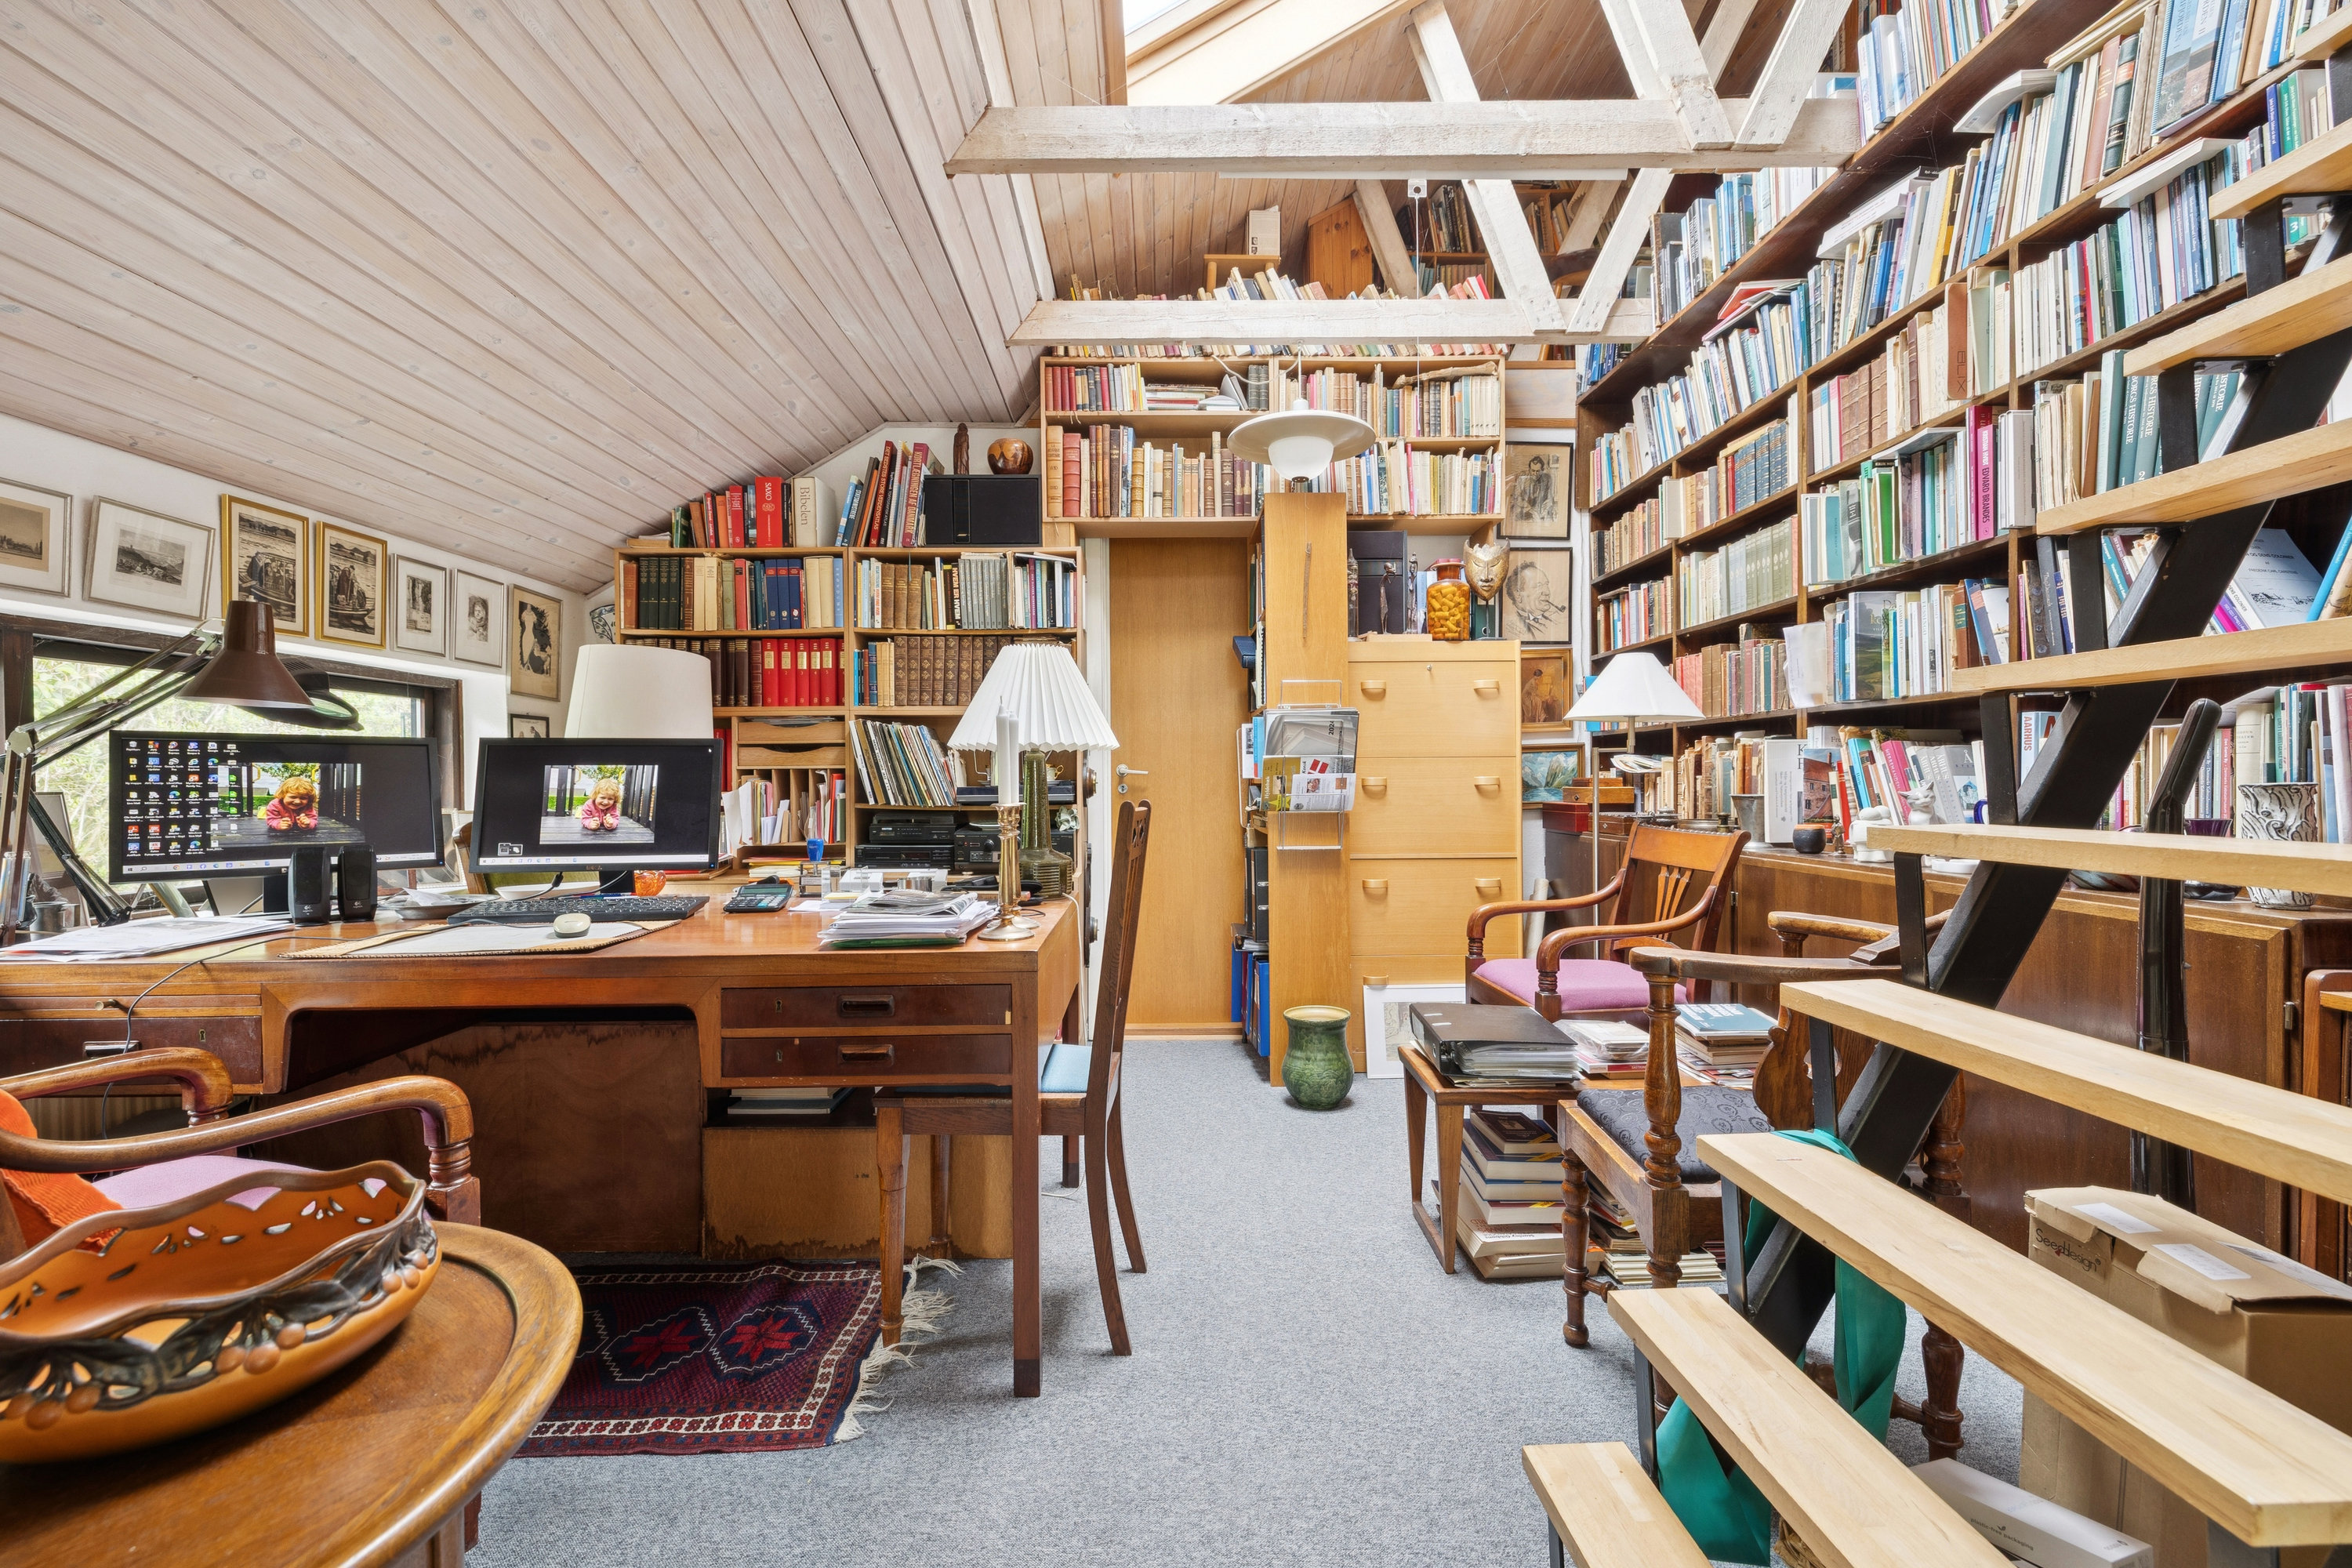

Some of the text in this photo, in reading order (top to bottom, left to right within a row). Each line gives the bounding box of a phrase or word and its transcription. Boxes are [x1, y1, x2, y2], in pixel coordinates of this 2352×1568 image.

[2290, 222, 2298, 233] 3
[1957, 350, 1966, 393] BLIX
[2216, 376, 2228, 412] ISTORIE
[2126, 405, 2136, 445] HISTORIE
[2145, 397, 2156, 437] HISTORIE
[1981, 430, 1989, 452] KRISTIAN
[1981, 452, 1989, 466] HVIDT
[2139, 471, 2145, 480] 2
[800, 487, 809, 525] Bibelen
[874, 495, 884, 530] VERDENSATLAS
[904, 451, 922, 542] KORTLÆGNINGEN AF DANMARK
[1982, 494, 1991, 523] BRANDES
[953, 589, 959, 599] ER
[2024, 716, 2033, 751] AARHUS
[1970, 1517, 2034, 1551] plastic-free packaging
